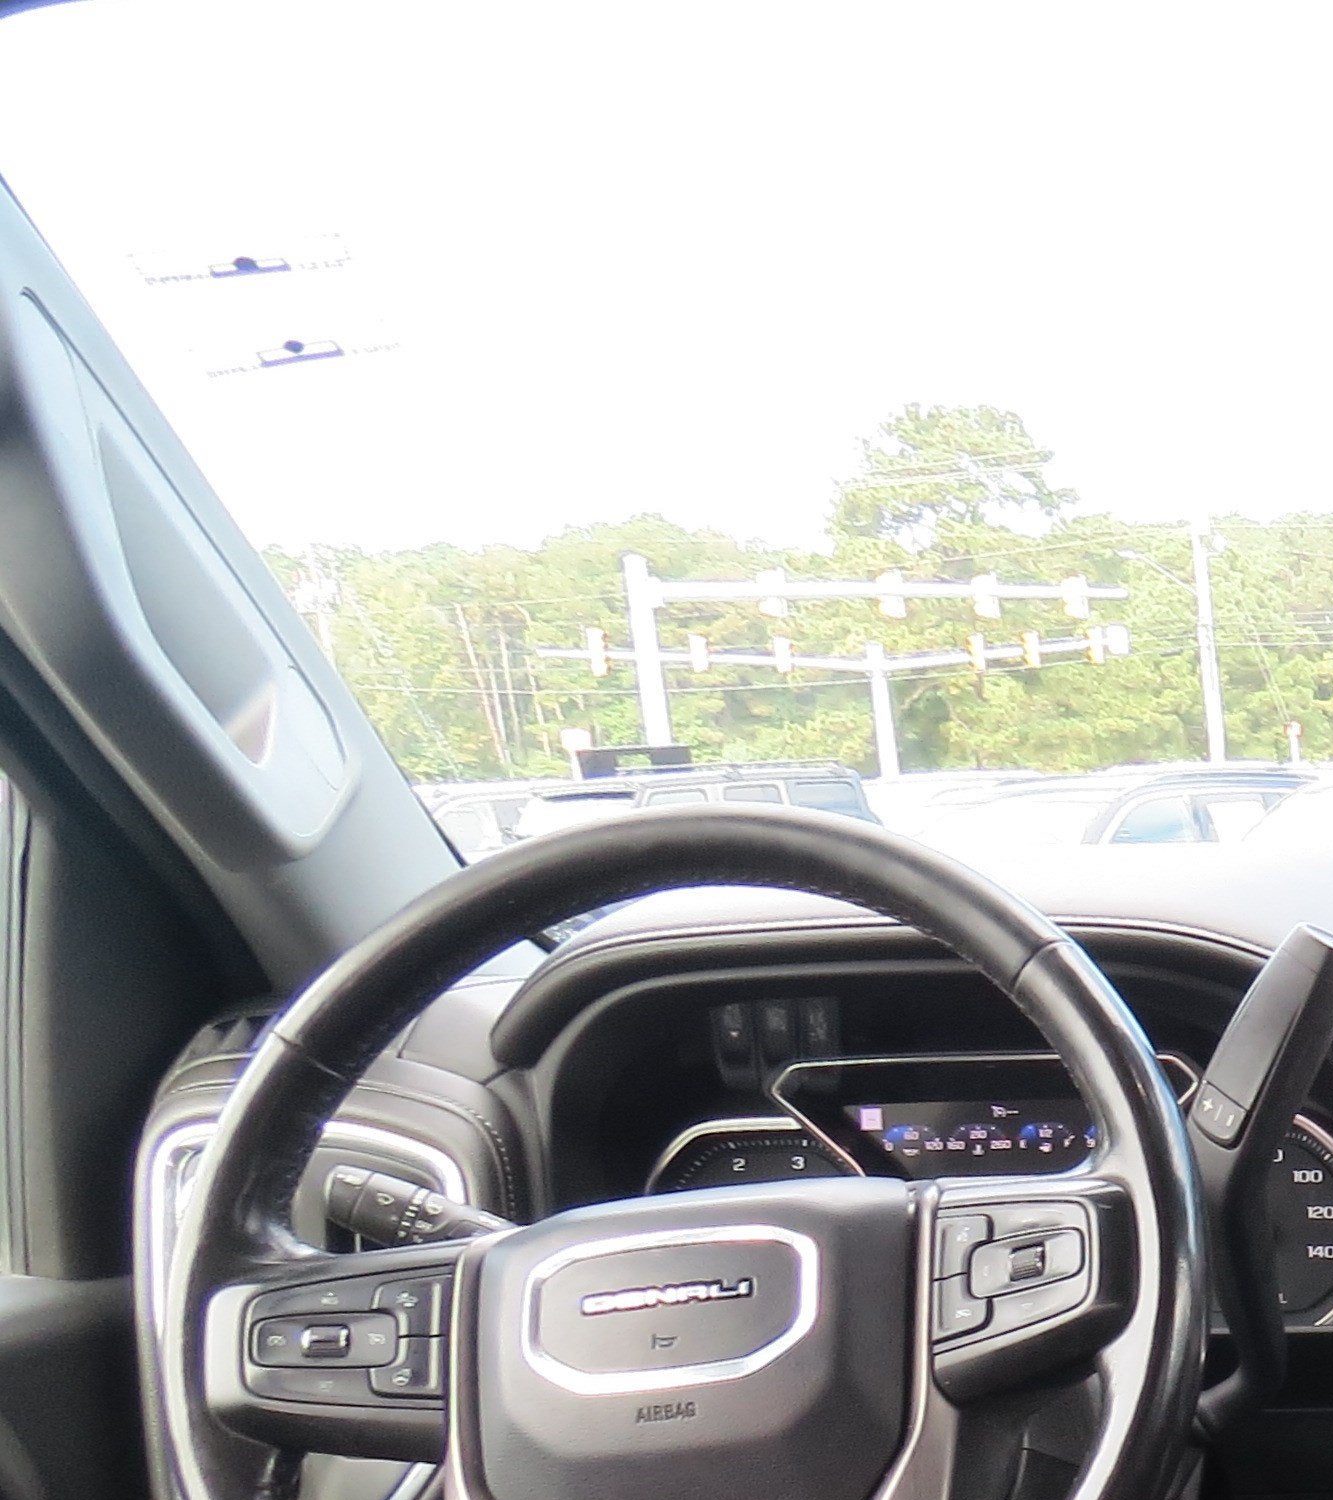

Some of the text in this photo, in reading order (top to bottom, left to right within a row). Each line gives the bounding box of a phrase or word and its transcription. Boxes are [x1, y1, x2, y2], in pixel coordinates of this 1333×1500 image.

[732, 1158, 747, 1171] 2
[791, 1156, 806, 1170] 3
[1293, 1170, 1324, 1184] 100
[581, 1278, 753, 1316] DENALI
[635, 1401, 697, 1424] AIRBAG
